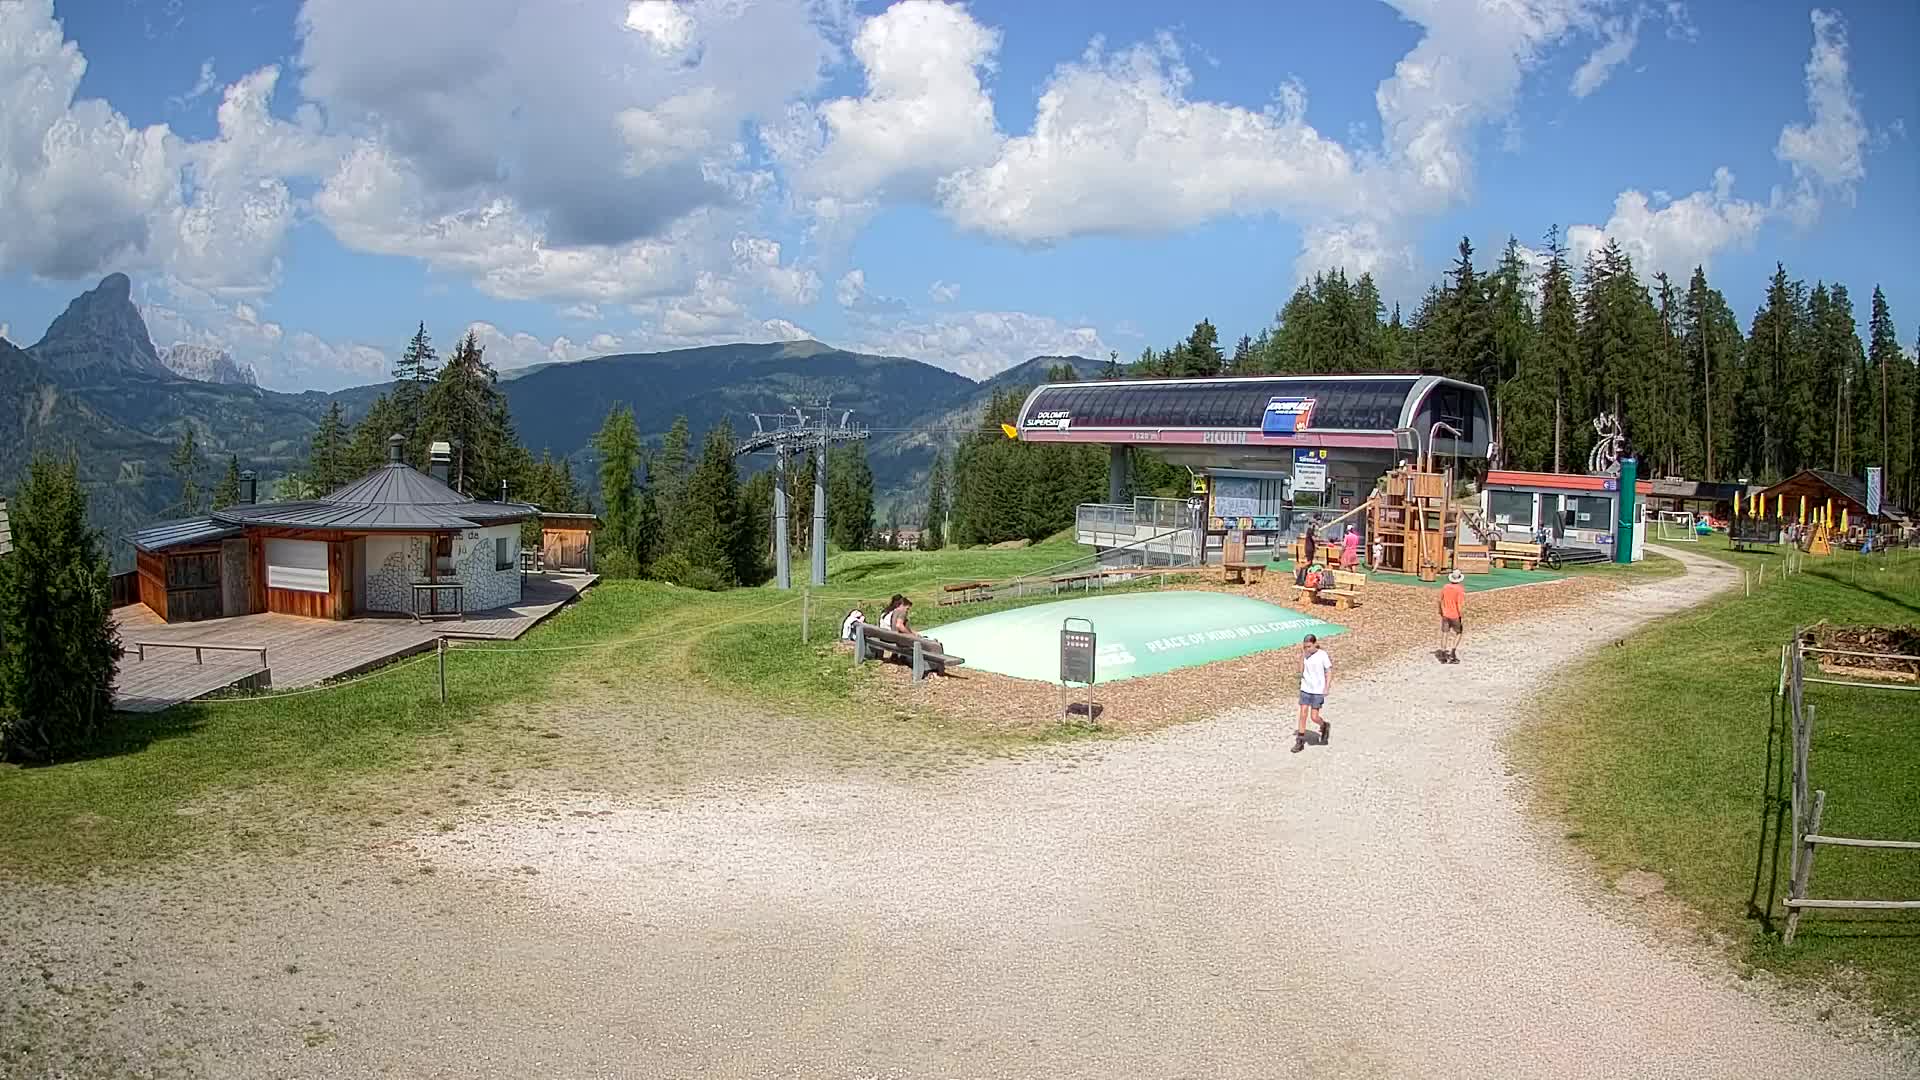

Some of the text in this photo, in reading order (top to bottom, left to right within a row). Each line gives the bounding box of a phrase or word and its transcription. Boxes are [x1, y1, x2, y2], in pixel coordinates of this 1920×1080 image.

[1203, 431, 1246, 444] PICULIN
[1144, 636, 1190, 652] PEACE
[1188, 632, 1206, 645] OF
[1205, 629, 1236, 641] MIND
[1234, 627, 1250, 639] IN
[1249, 624, 1271, 635] ALL
